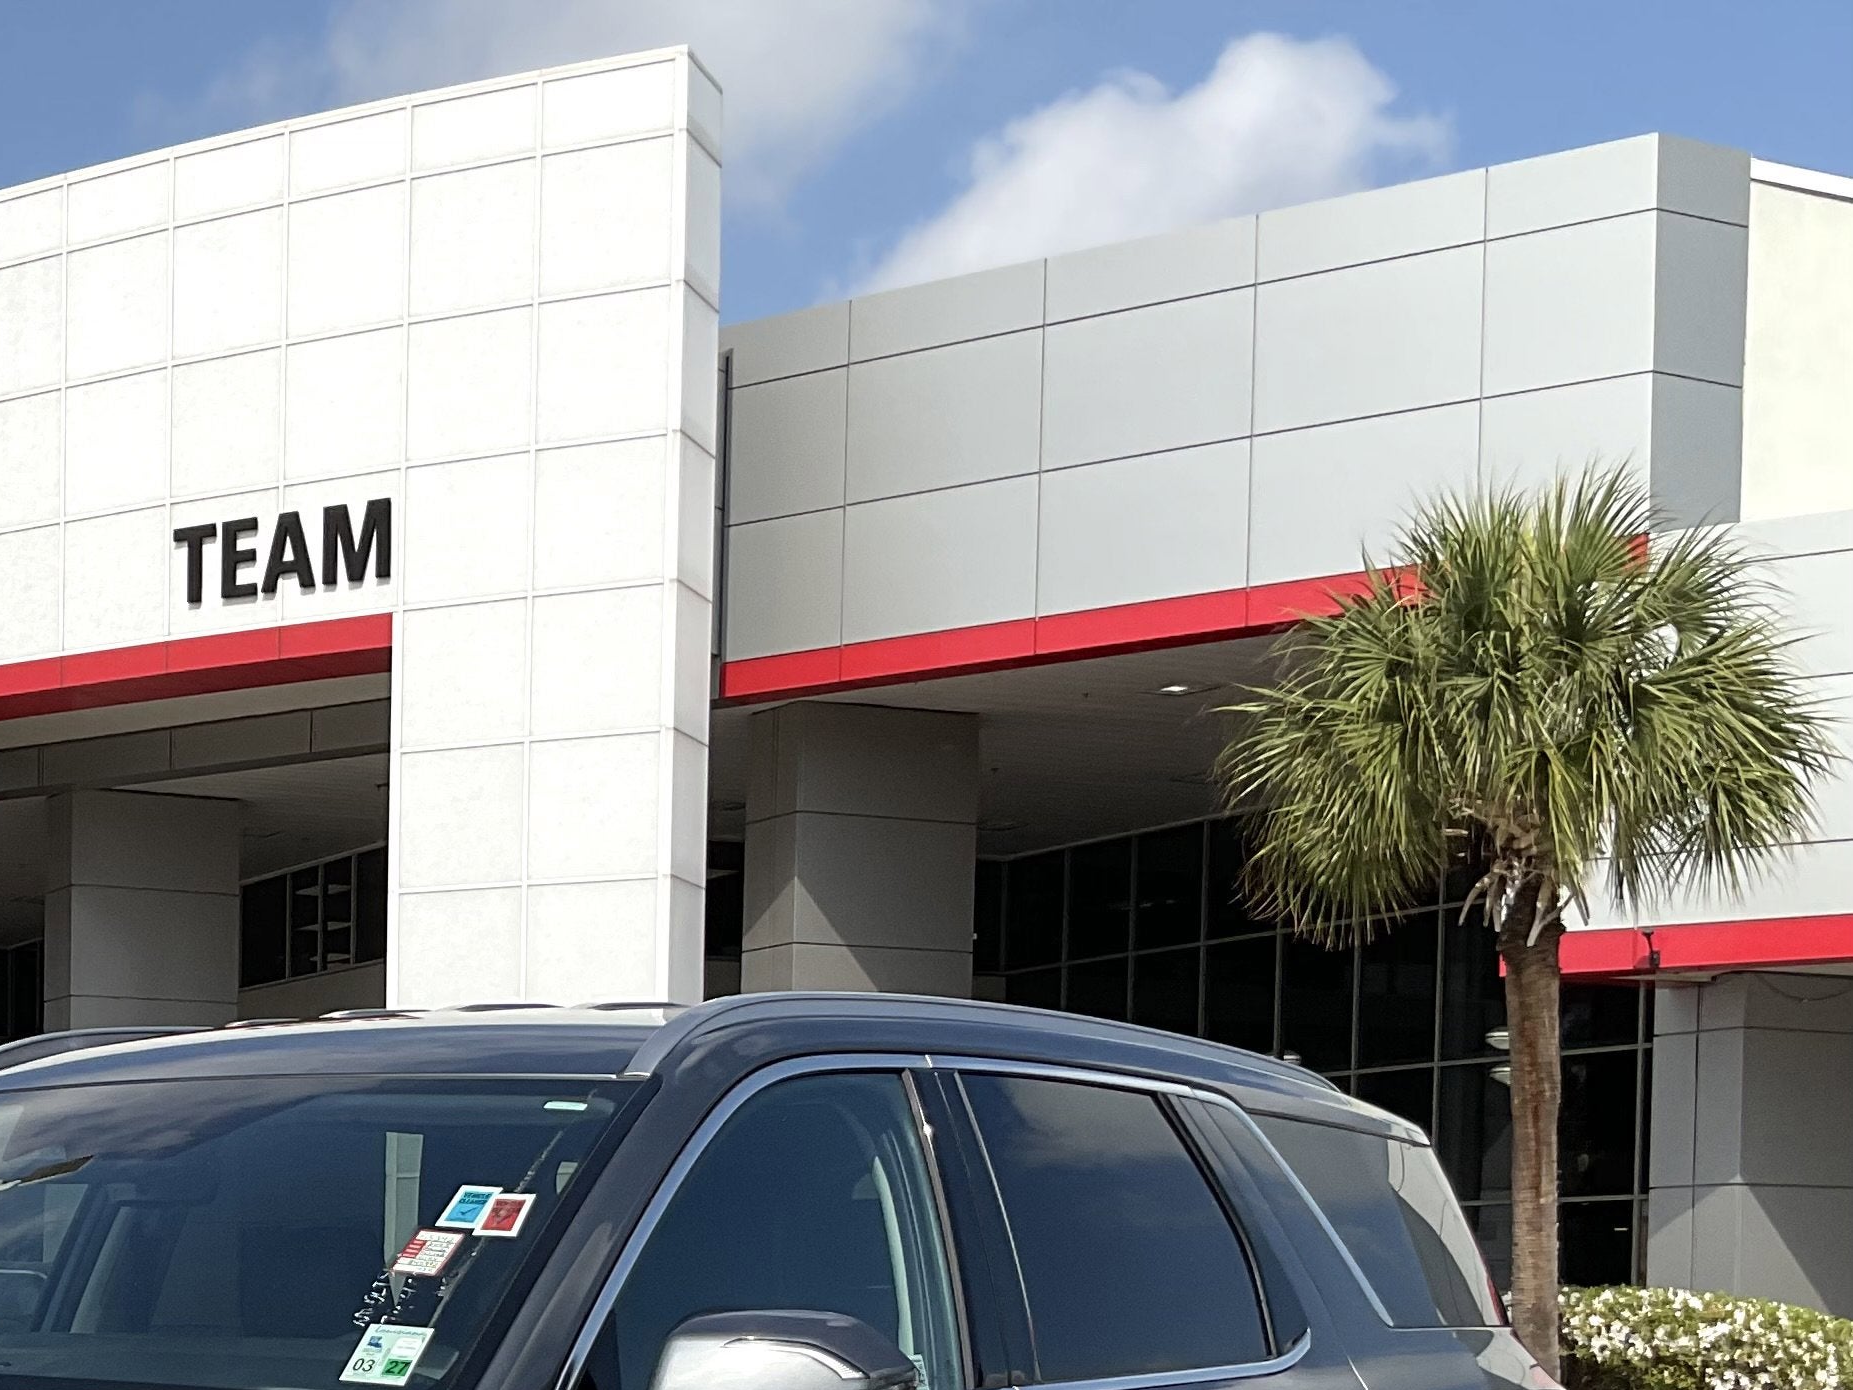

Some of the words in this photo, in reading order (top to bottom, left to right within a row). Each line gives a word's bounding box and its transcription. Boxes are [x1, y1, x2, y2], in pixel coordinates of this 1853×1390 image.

[173, 498, 392, 605] TEAM
[352, 1358, 376, 1372] 03
[385, 1360, 411, 1375] 27
